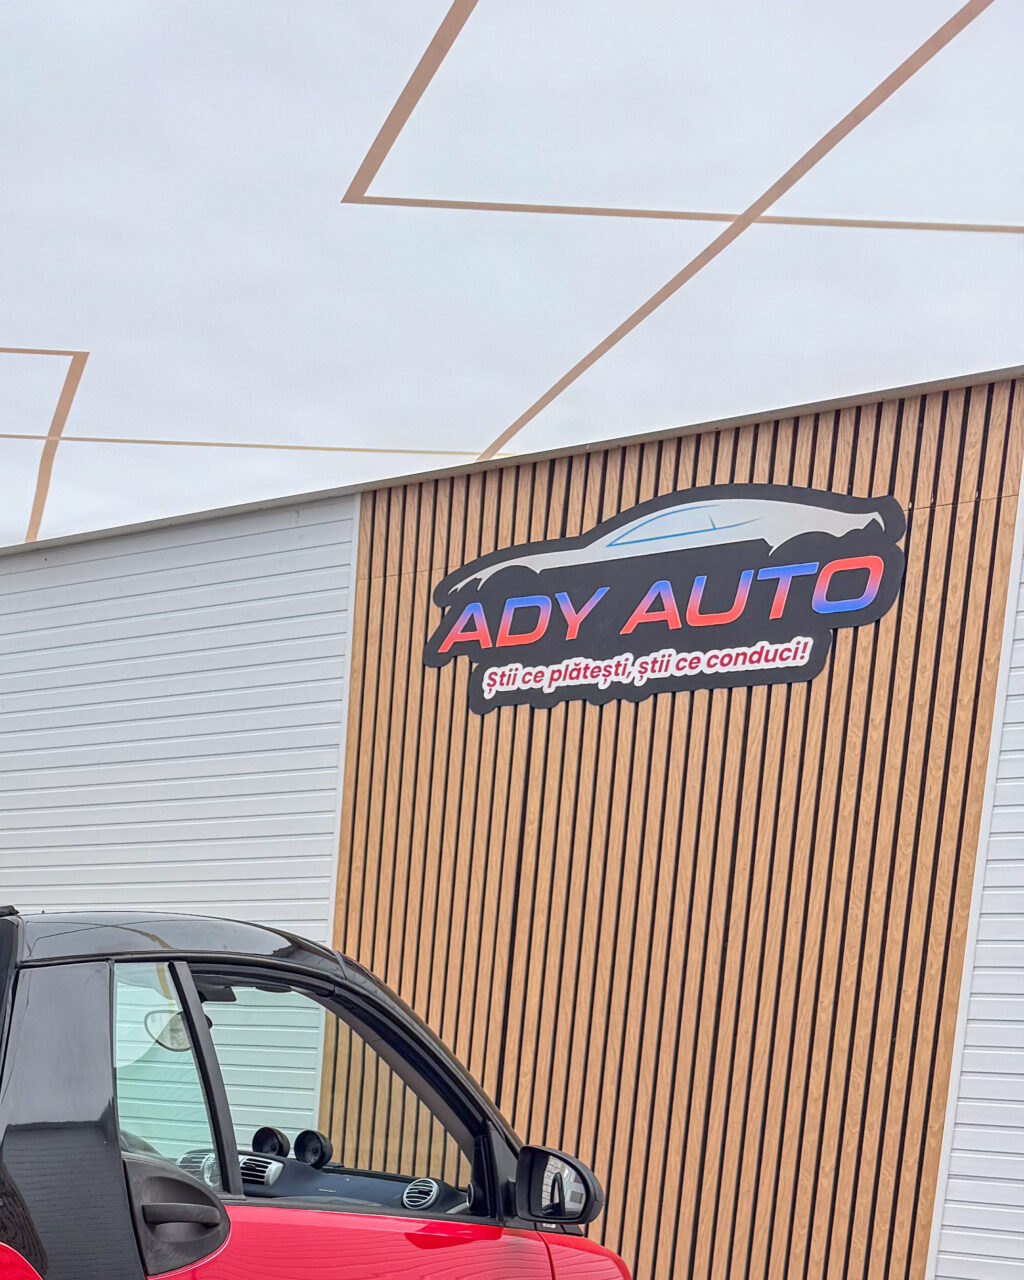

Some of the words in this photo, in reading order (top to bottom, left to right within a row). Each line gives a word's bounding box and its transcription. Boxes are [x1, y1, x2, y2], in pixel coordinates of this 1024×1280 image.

[437, 586, 610, 654] ADY
[619, 555, 884, 634] AUTO
[486, 667, 518, 694] Știi
[521, 671, 545, 685] ce
[546, 658, 632, 689] plătești,
[637, 653, 672, 682] știi
[675, 656, 701, 672] ce
[705, 640, 809, 670] conduci!
